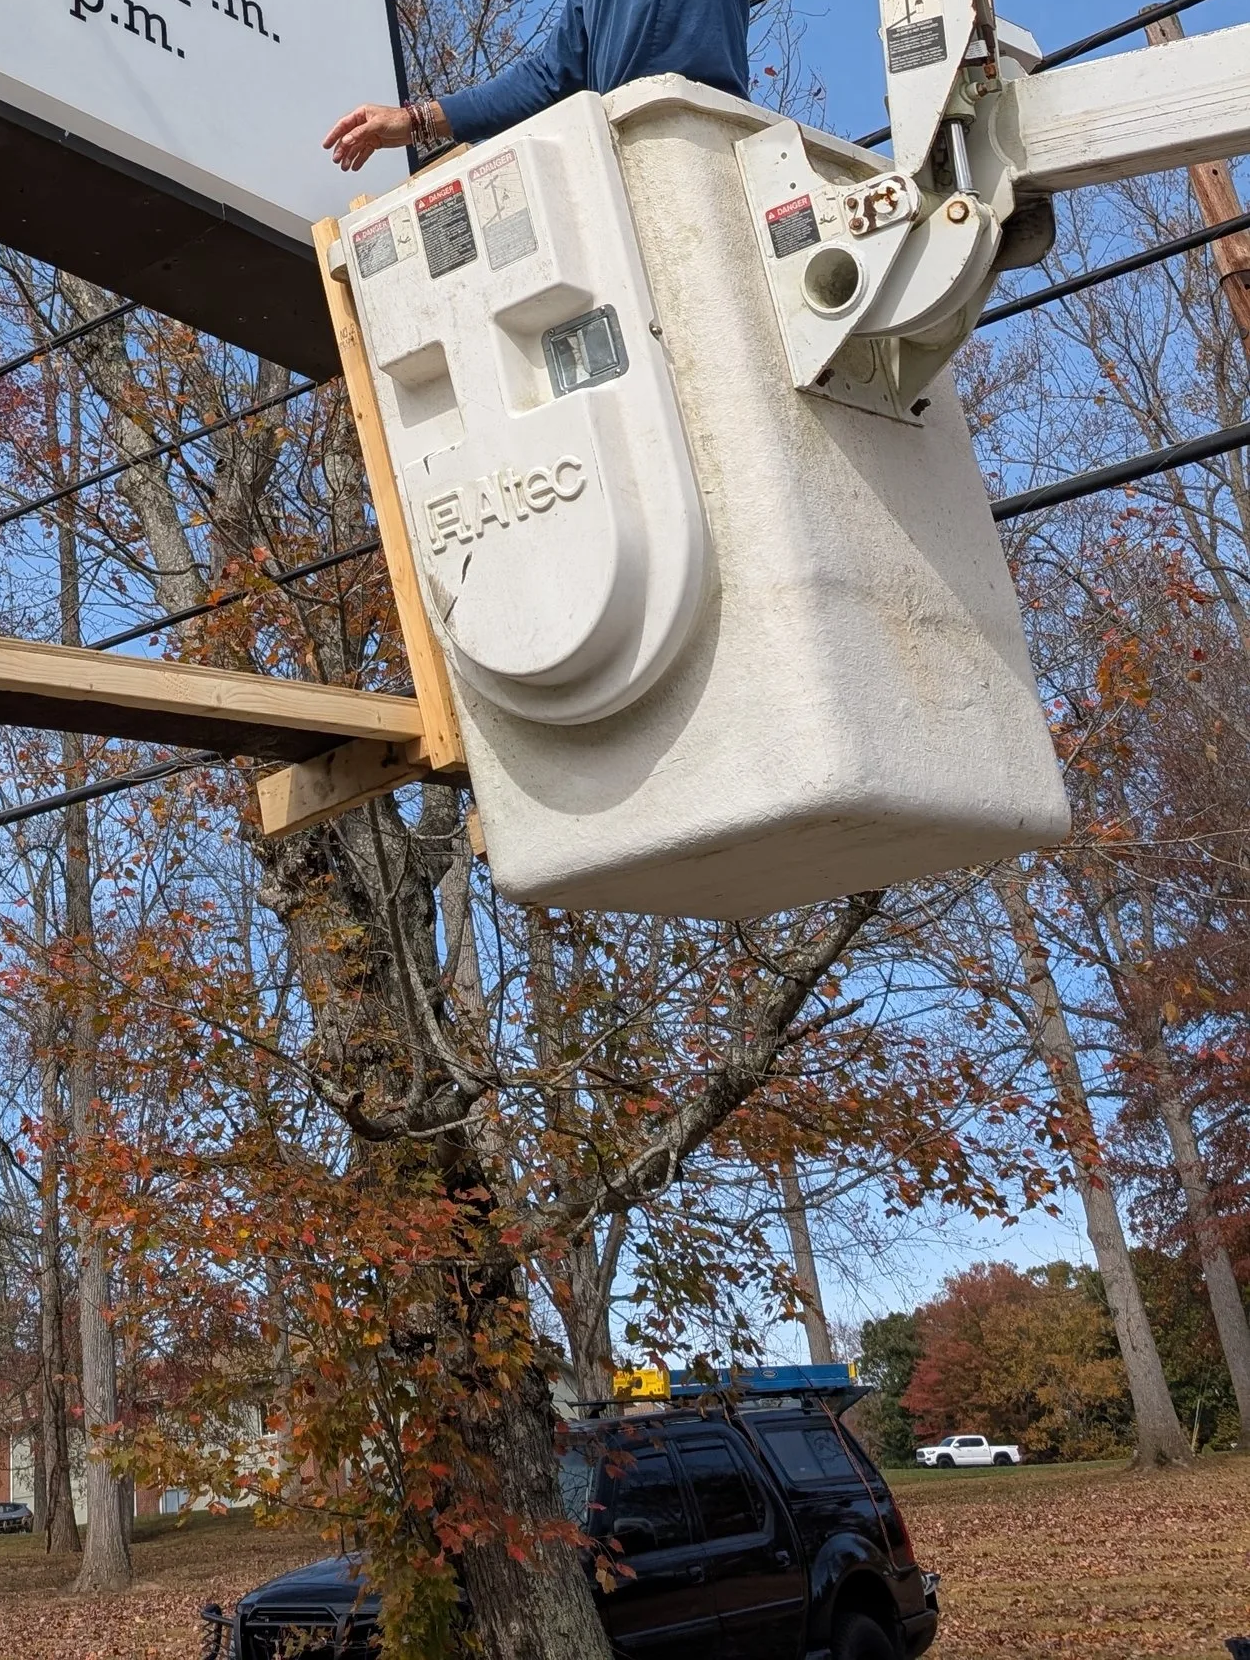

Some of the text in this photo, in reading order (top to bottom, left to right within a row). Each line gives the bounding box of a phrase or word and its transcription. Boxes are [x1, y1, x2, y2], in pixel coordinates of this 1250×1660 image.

[479, 152, 513, 175] DANGER
[428, 184, 455, 203] DANGER
[776, 197, 808, 216] DANGER
[475, 453, 588, 539] Altec
